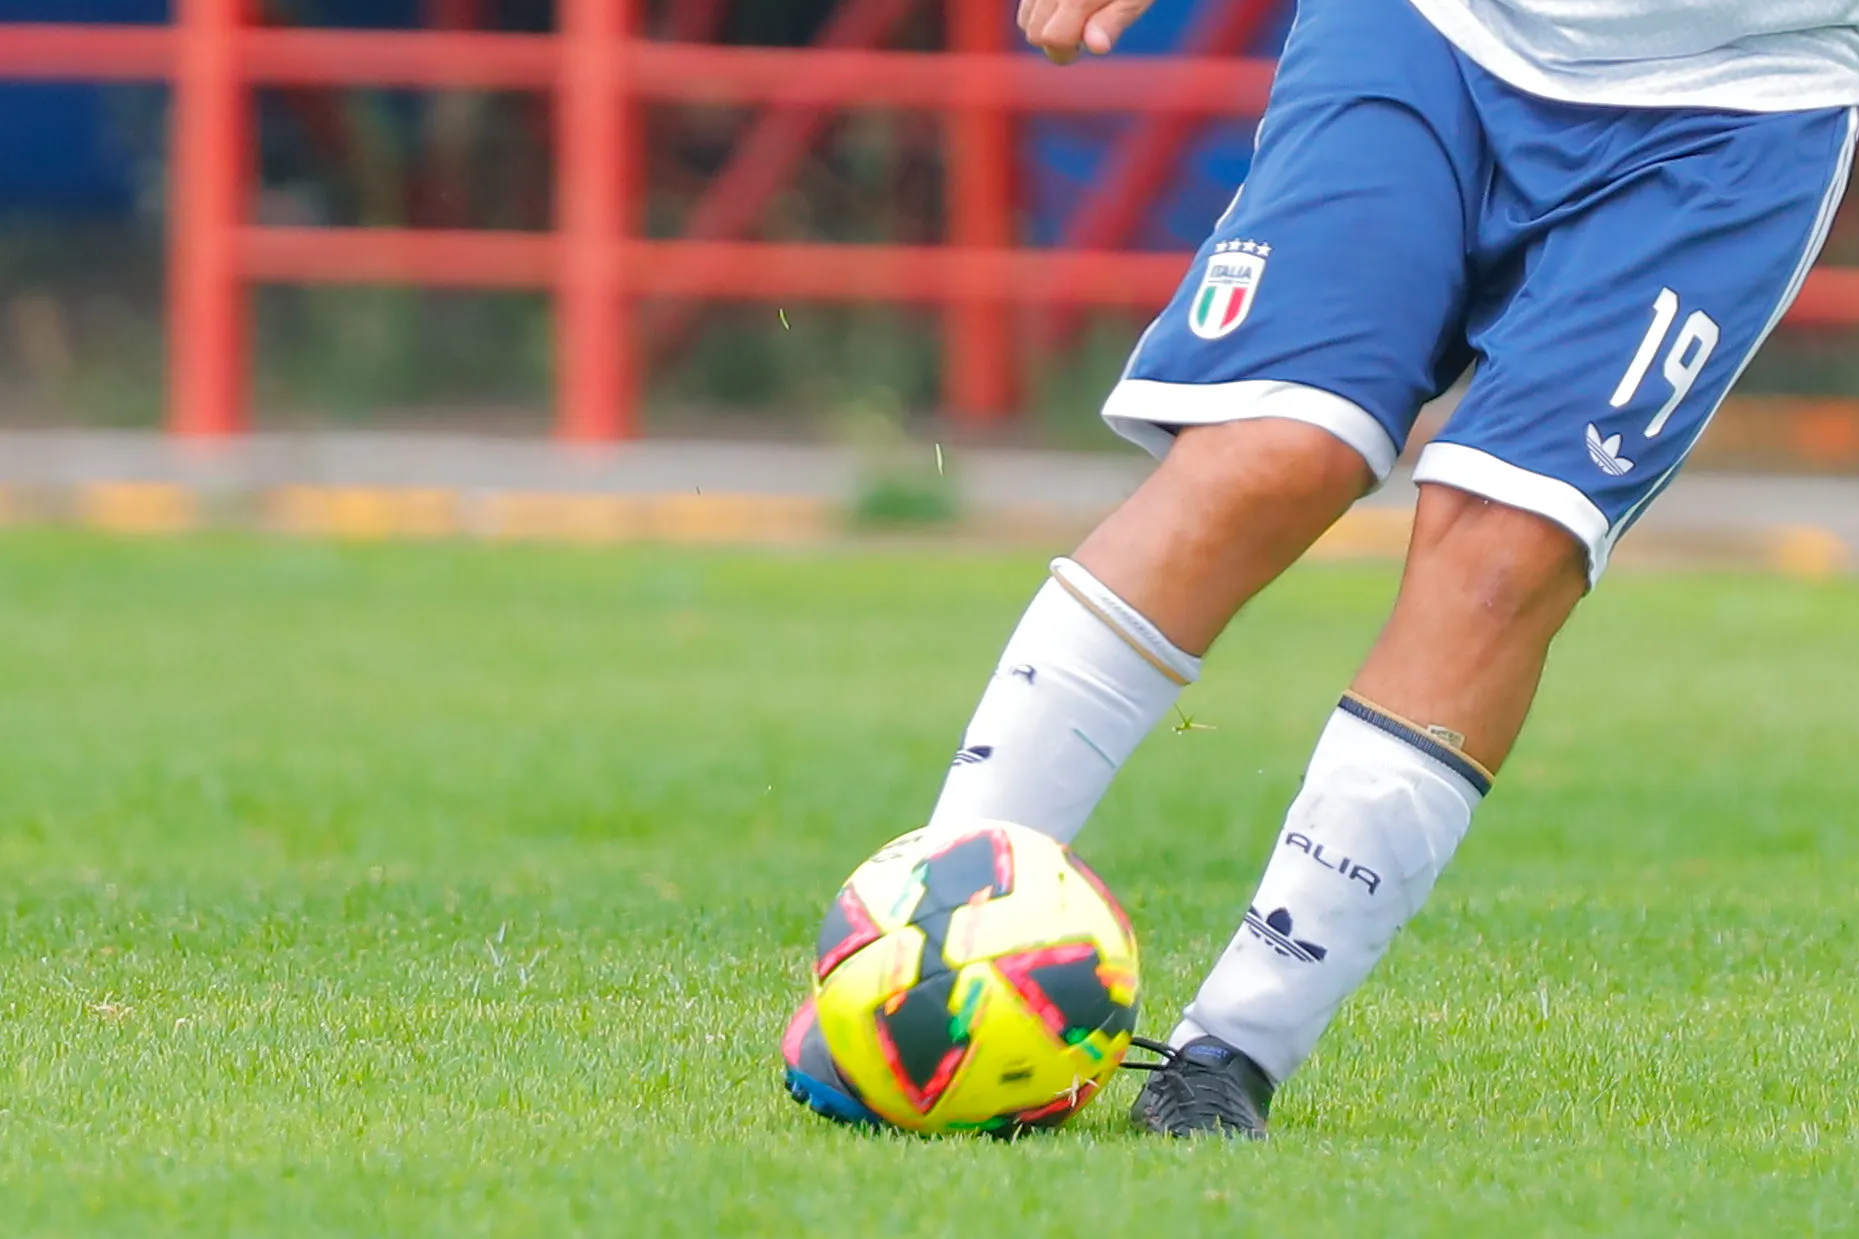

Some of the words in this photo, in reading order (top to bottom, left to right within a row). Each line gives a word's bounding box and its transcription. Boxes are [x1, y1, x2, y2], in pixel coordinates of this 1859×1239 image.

[1209, 264, 1252, 279] ITALIA
[1609, 286, 1720, 438] 19
[1285, 832, 1381, 896] ALIA
